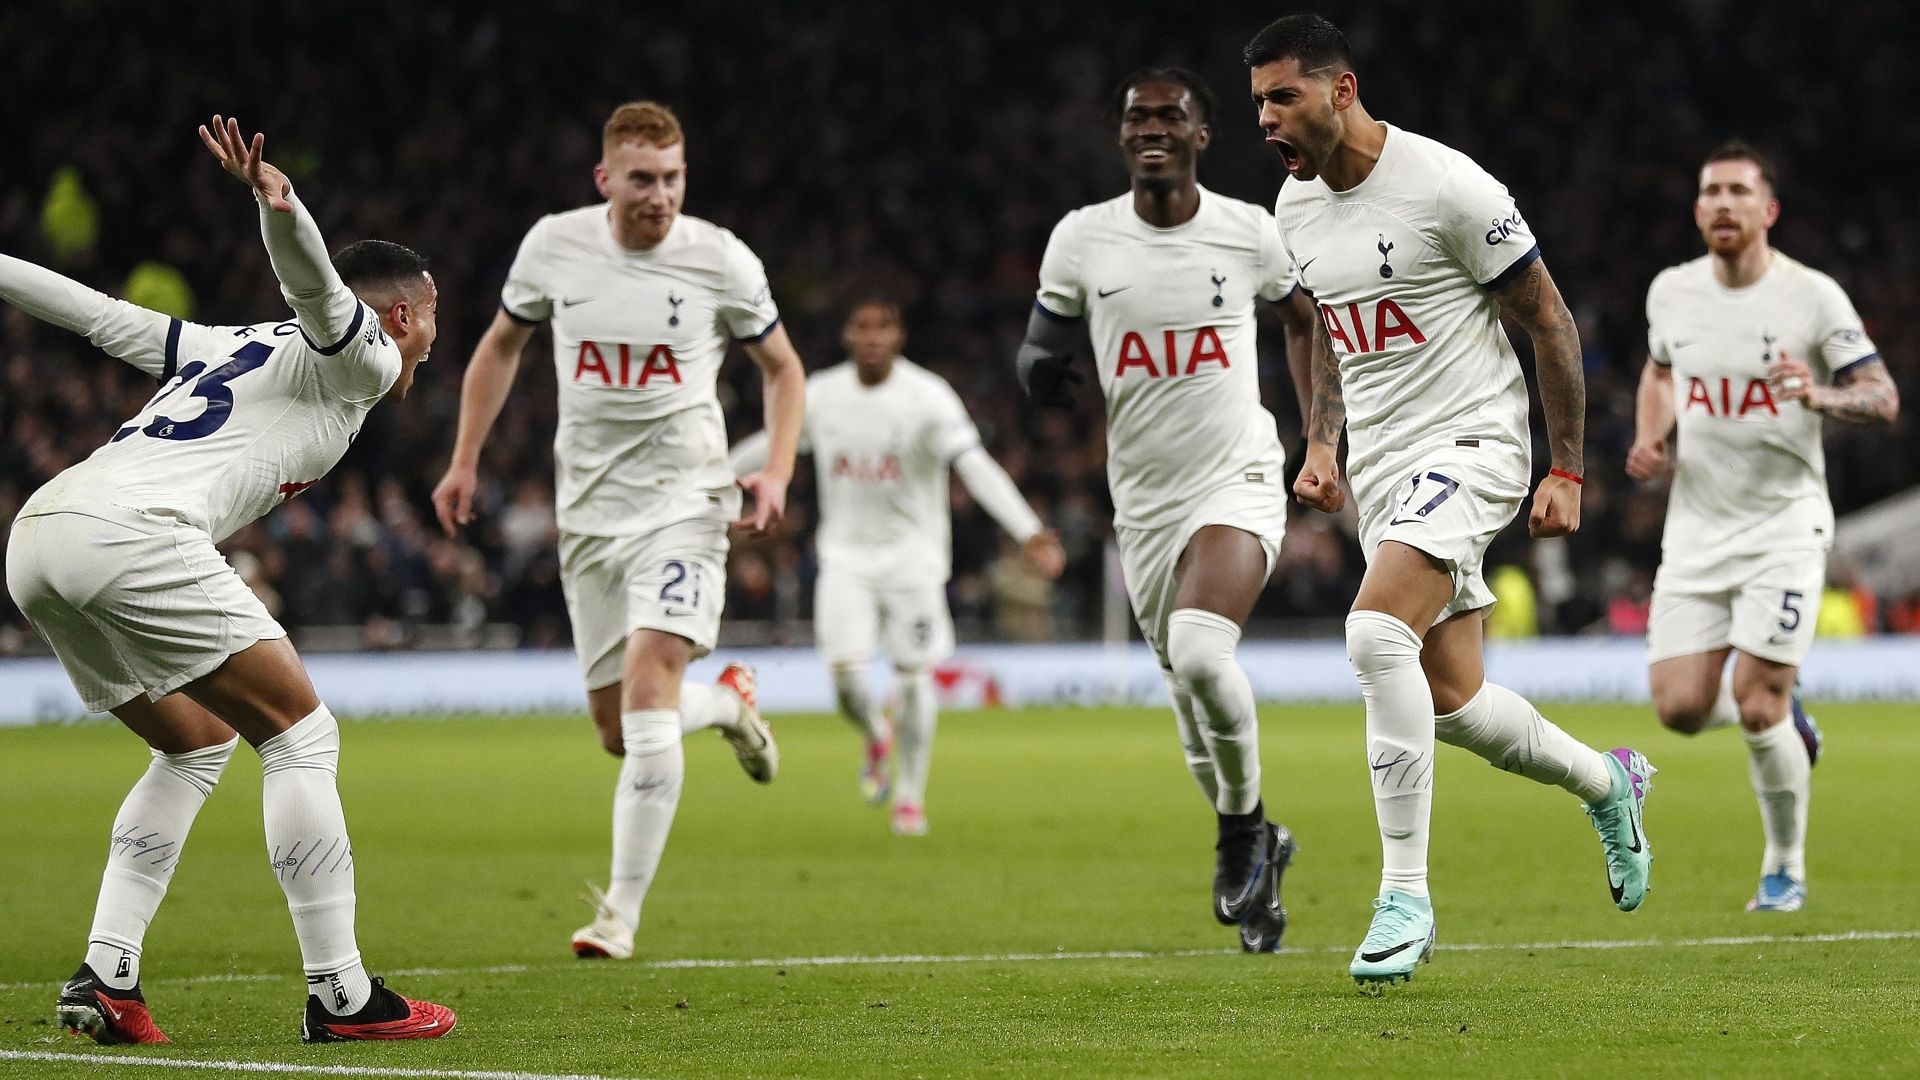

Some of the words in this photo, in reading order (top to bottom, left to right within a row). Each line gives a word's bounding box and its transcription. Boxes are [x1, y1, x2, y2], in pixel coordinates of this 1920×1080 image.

[1320, 298, 1428, 353] AIA
[573, 340, 682, 386] AIA
[1116, 325, 1230, 377] AIA
[1687, 376, 1778, 418] AIA
[660, 561, 701, 607] 21
[1779, 591, 1803, 631] 5
